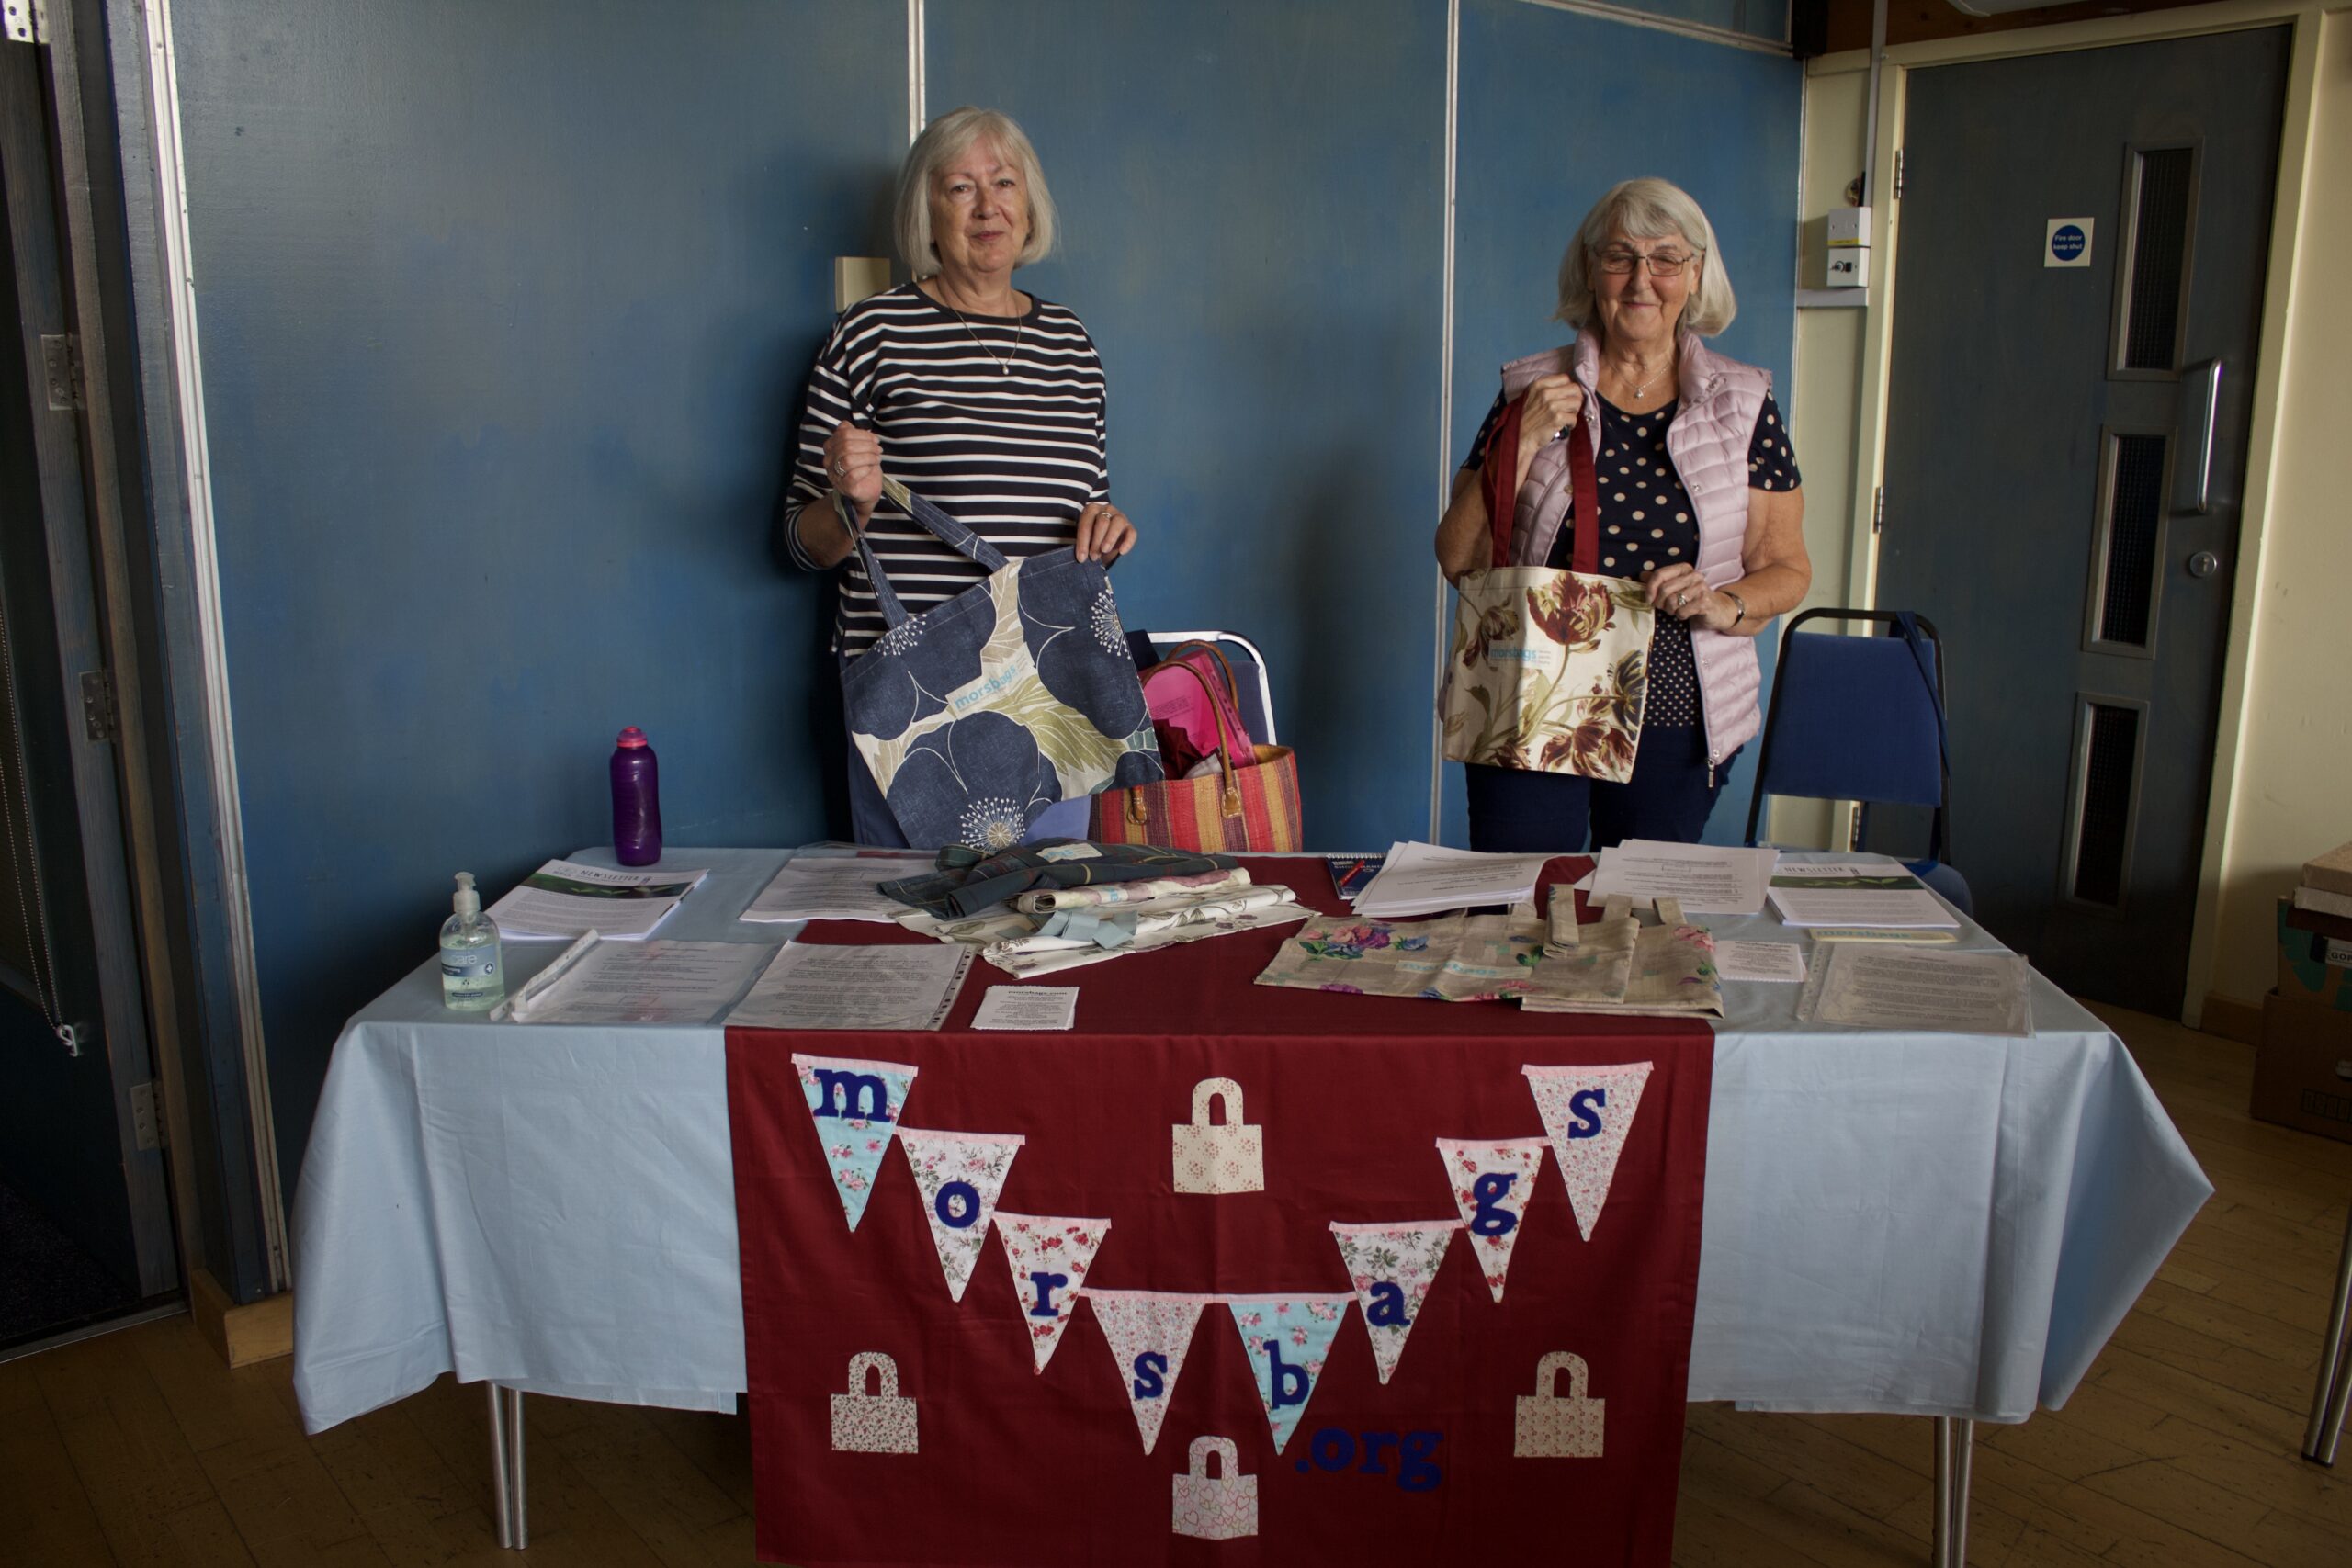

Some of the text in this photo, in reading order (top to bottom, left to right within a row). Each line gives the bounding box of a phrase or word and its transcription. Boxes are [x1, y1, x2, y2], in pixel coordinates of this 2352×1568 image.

[955, 664, 1017, 709] morsbags
[581, 869, 640, 882] NEWSLETTER
[1295, 1427, 1444, 1493] .org
